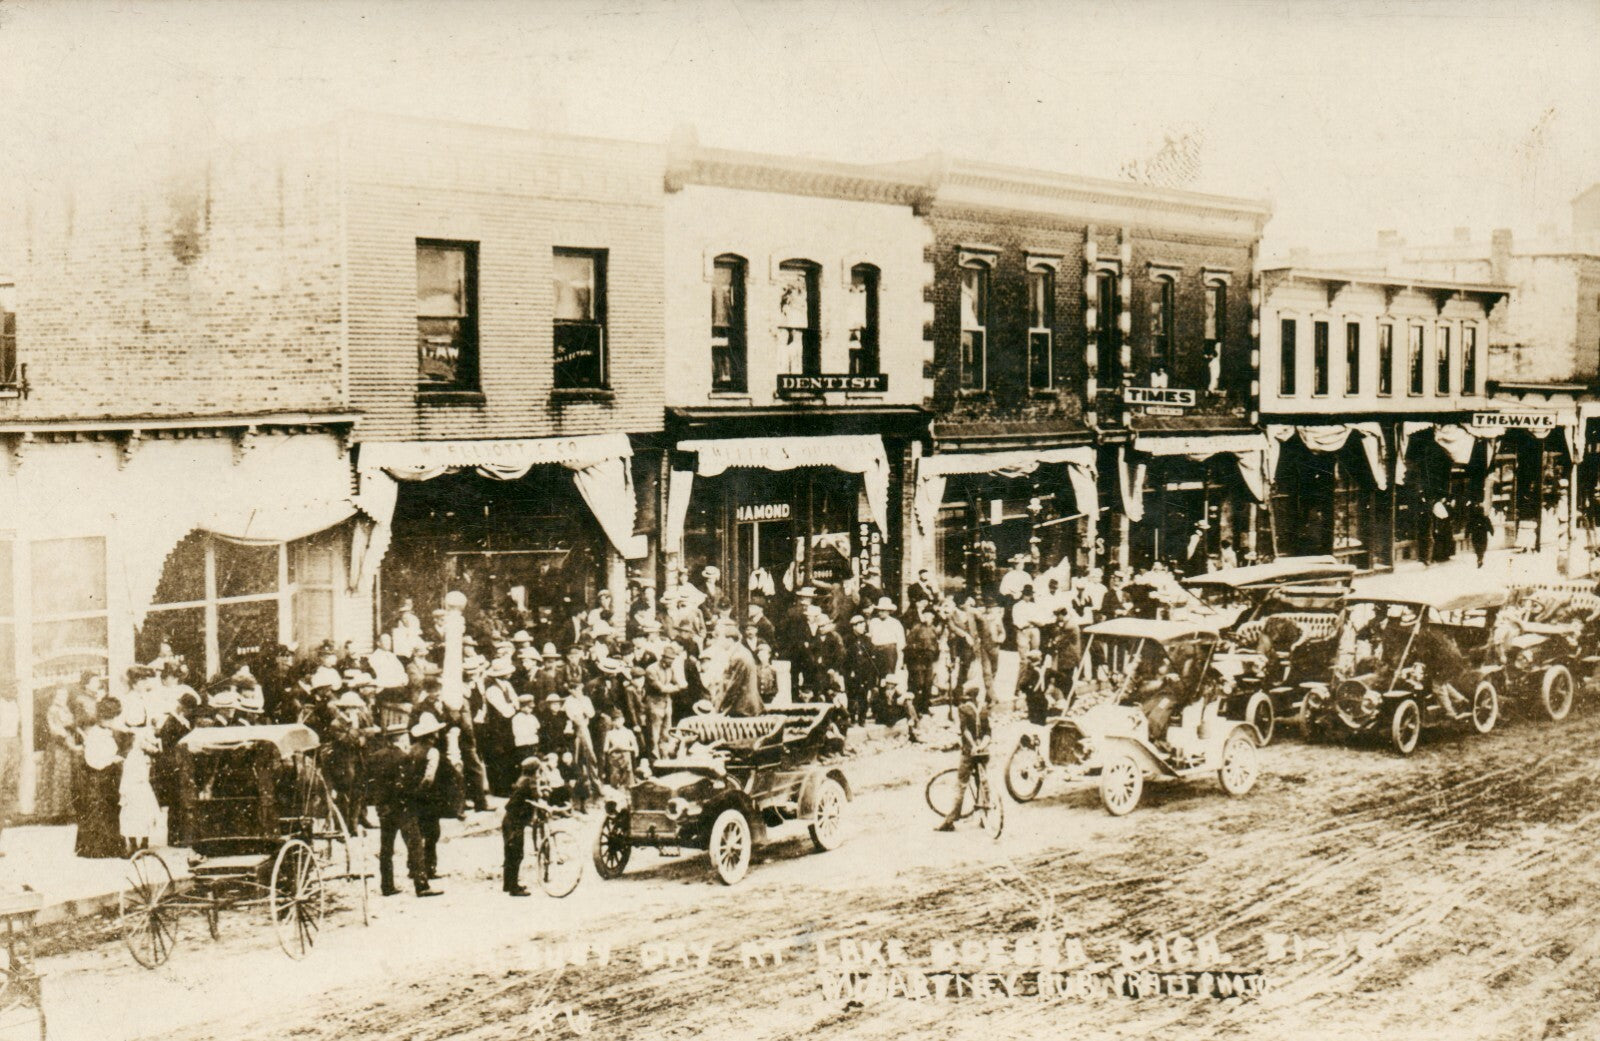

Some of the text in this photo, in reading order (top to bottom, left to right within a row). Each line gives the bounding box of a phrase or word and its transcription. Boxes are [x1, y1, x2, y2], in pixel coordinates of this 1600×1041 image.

[782, 377, 880, 389] DENTIST
[1127, 389, 1192, 403] TIMES
[1475, 414, 1553, 426] THE WAVE
